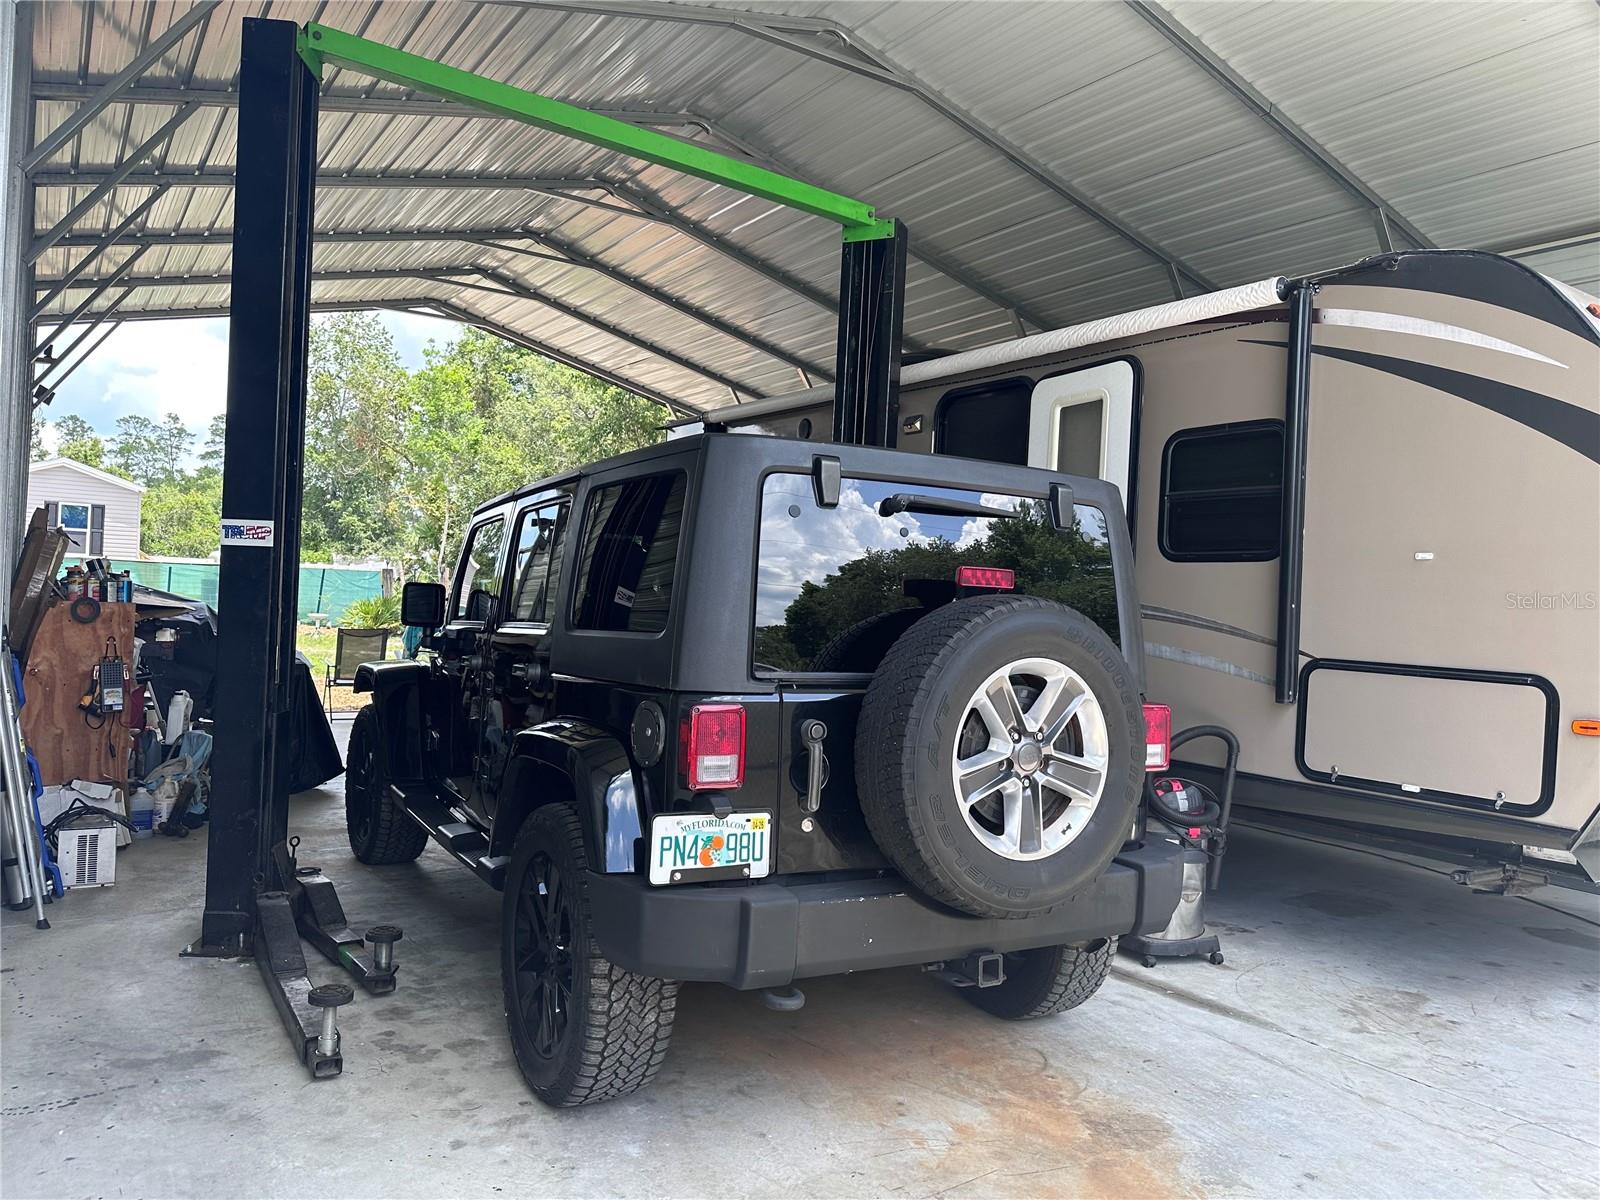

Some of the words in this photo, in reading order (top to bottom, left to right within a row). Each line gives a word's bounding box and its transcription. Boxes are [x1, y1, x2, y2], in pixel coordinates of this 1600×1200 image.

[222, 524, 272, 540] TRUMP
[680, 818, 747, 832] MYFLORIDA.COM
[659, 834, 699, 867] PN4
[725, 831, 764, 864] 98U
[928, 793, 1032, 899] DUELER
